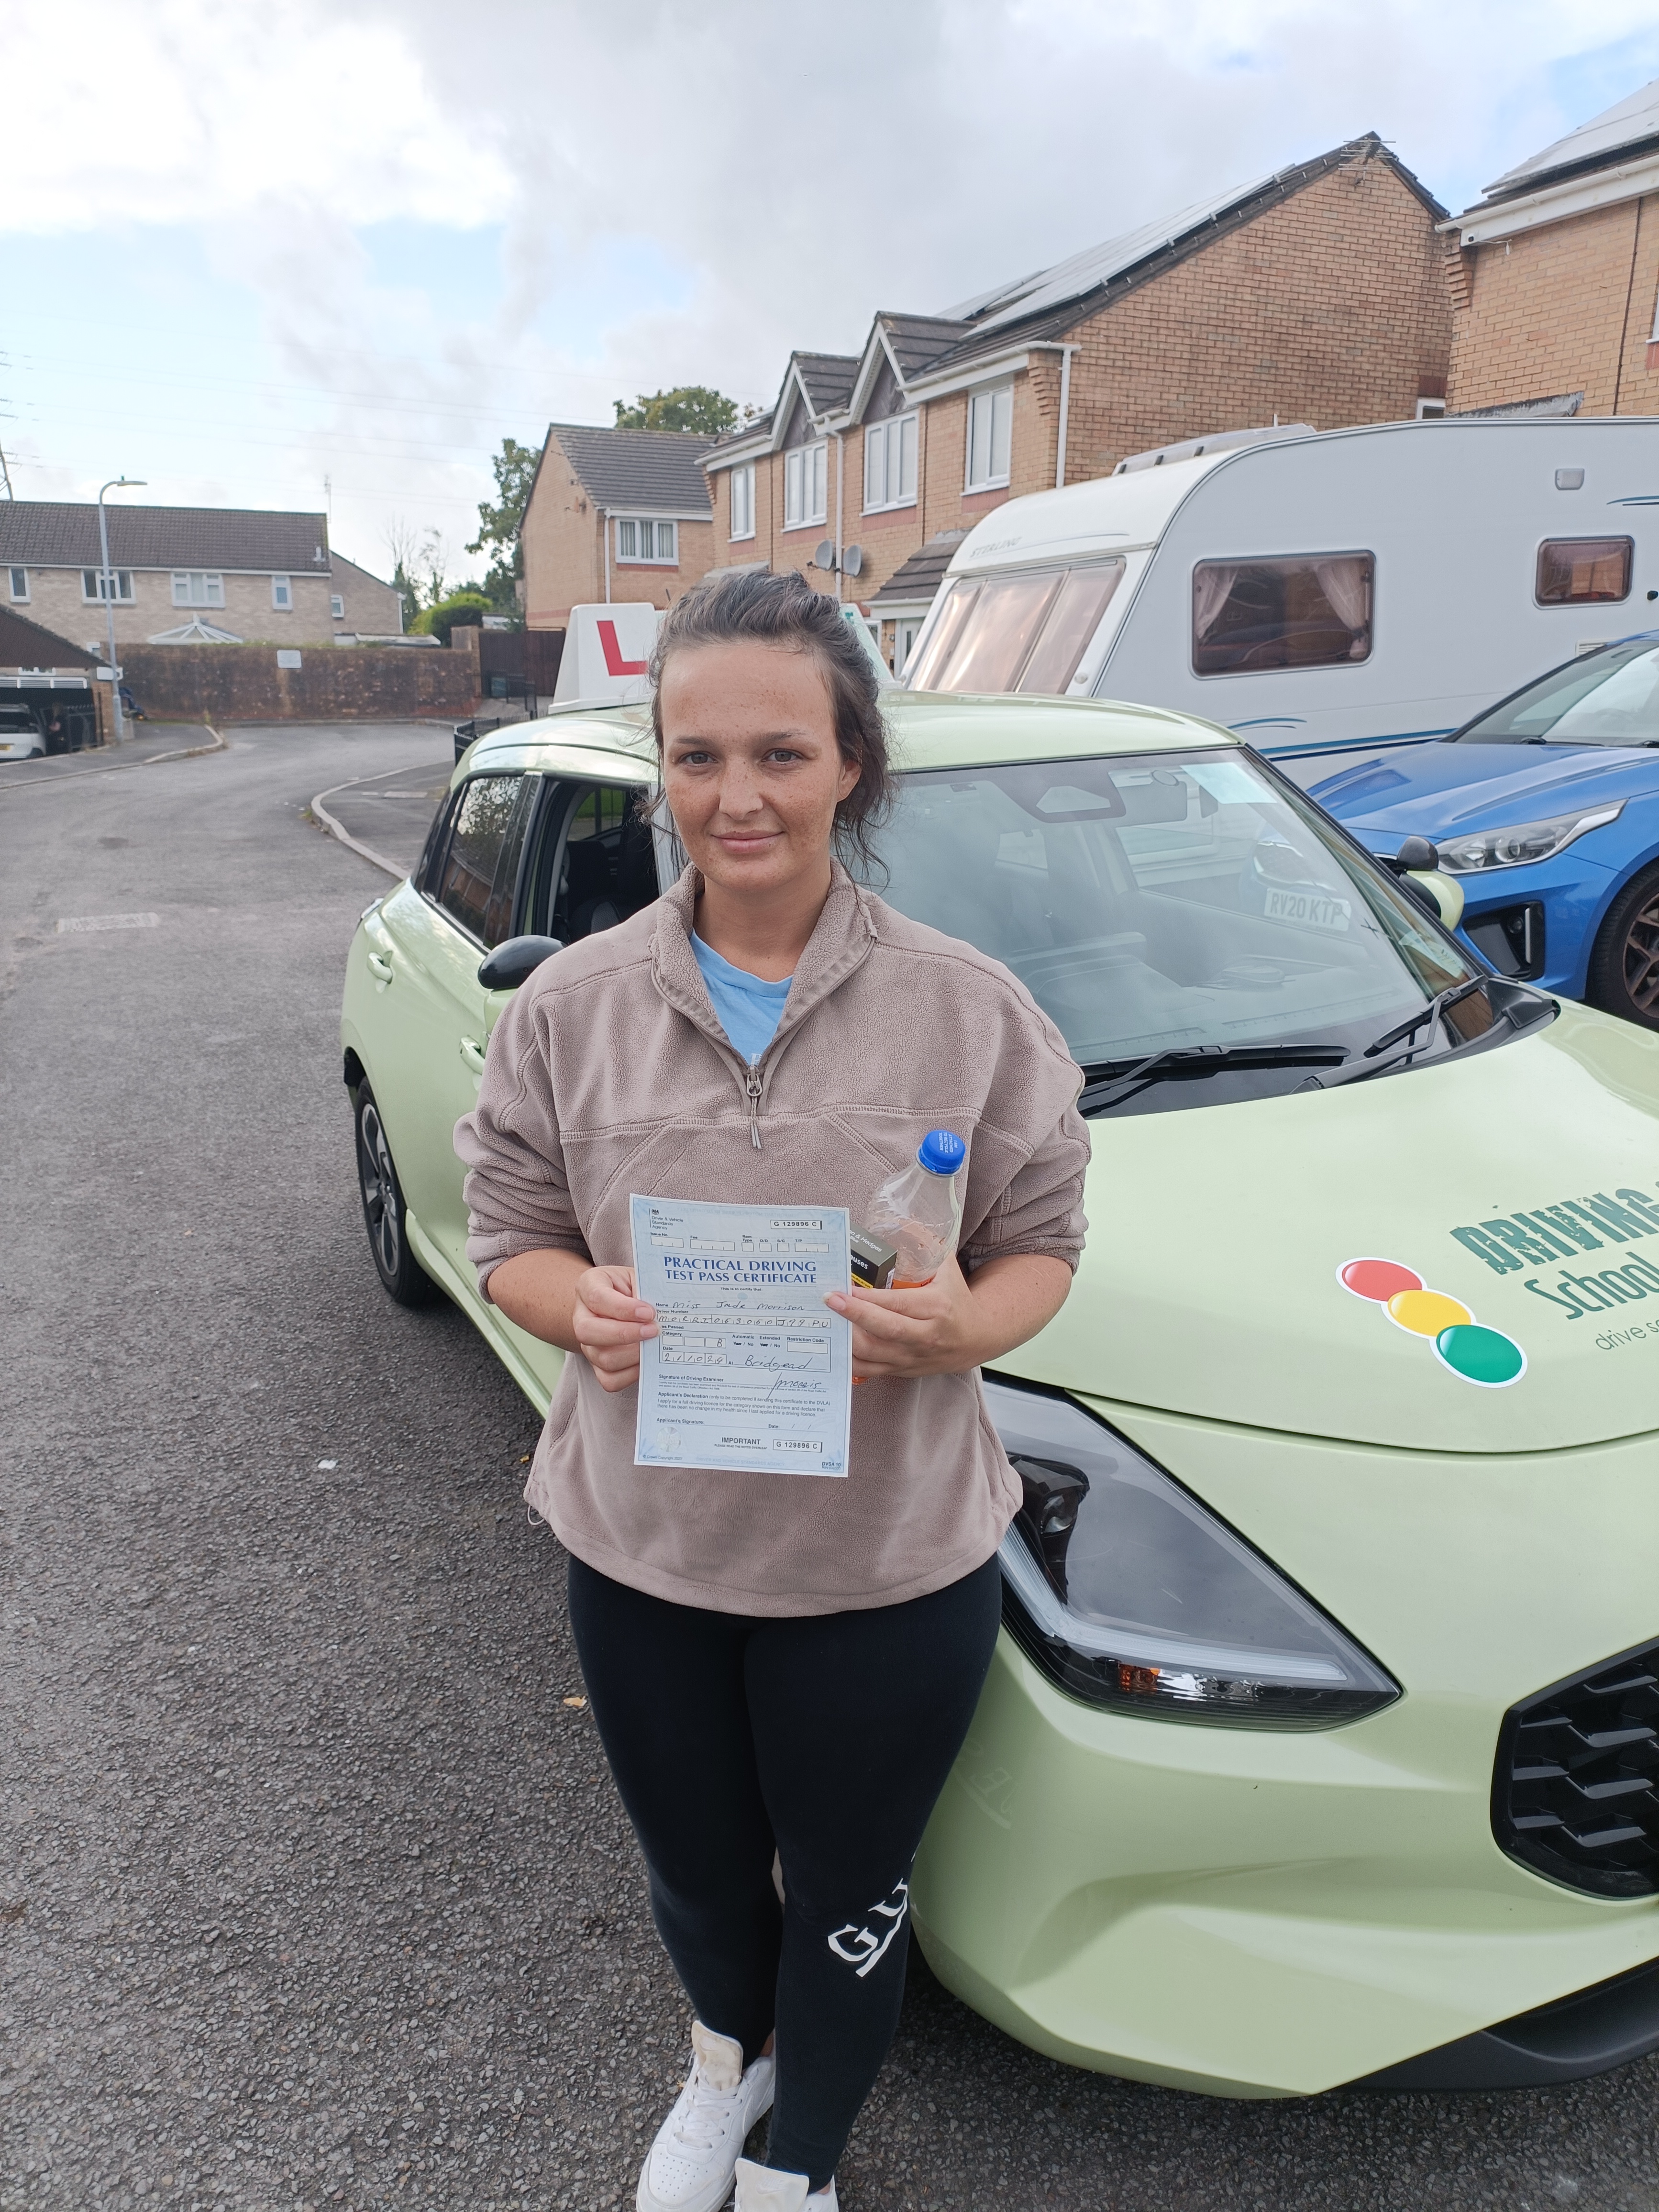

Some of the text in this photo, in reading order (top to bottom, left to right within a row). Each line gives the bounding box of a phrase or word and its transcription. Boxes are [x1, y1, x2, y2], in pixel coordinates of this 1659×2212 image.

[597, 620, 648, 676] L
[1270, 893, 1343, 924] RV20 KTP
[861, 1237, 882, 1252] Hedges
[664, 1256, 816, 1272] PRACTICAL DRIVING
[665, 1270, 817, 1283] TEST PASS CERTIFICATE
[717, 1338, 722, 1347] B
[1596, 1327, 1647, 1350] drive
